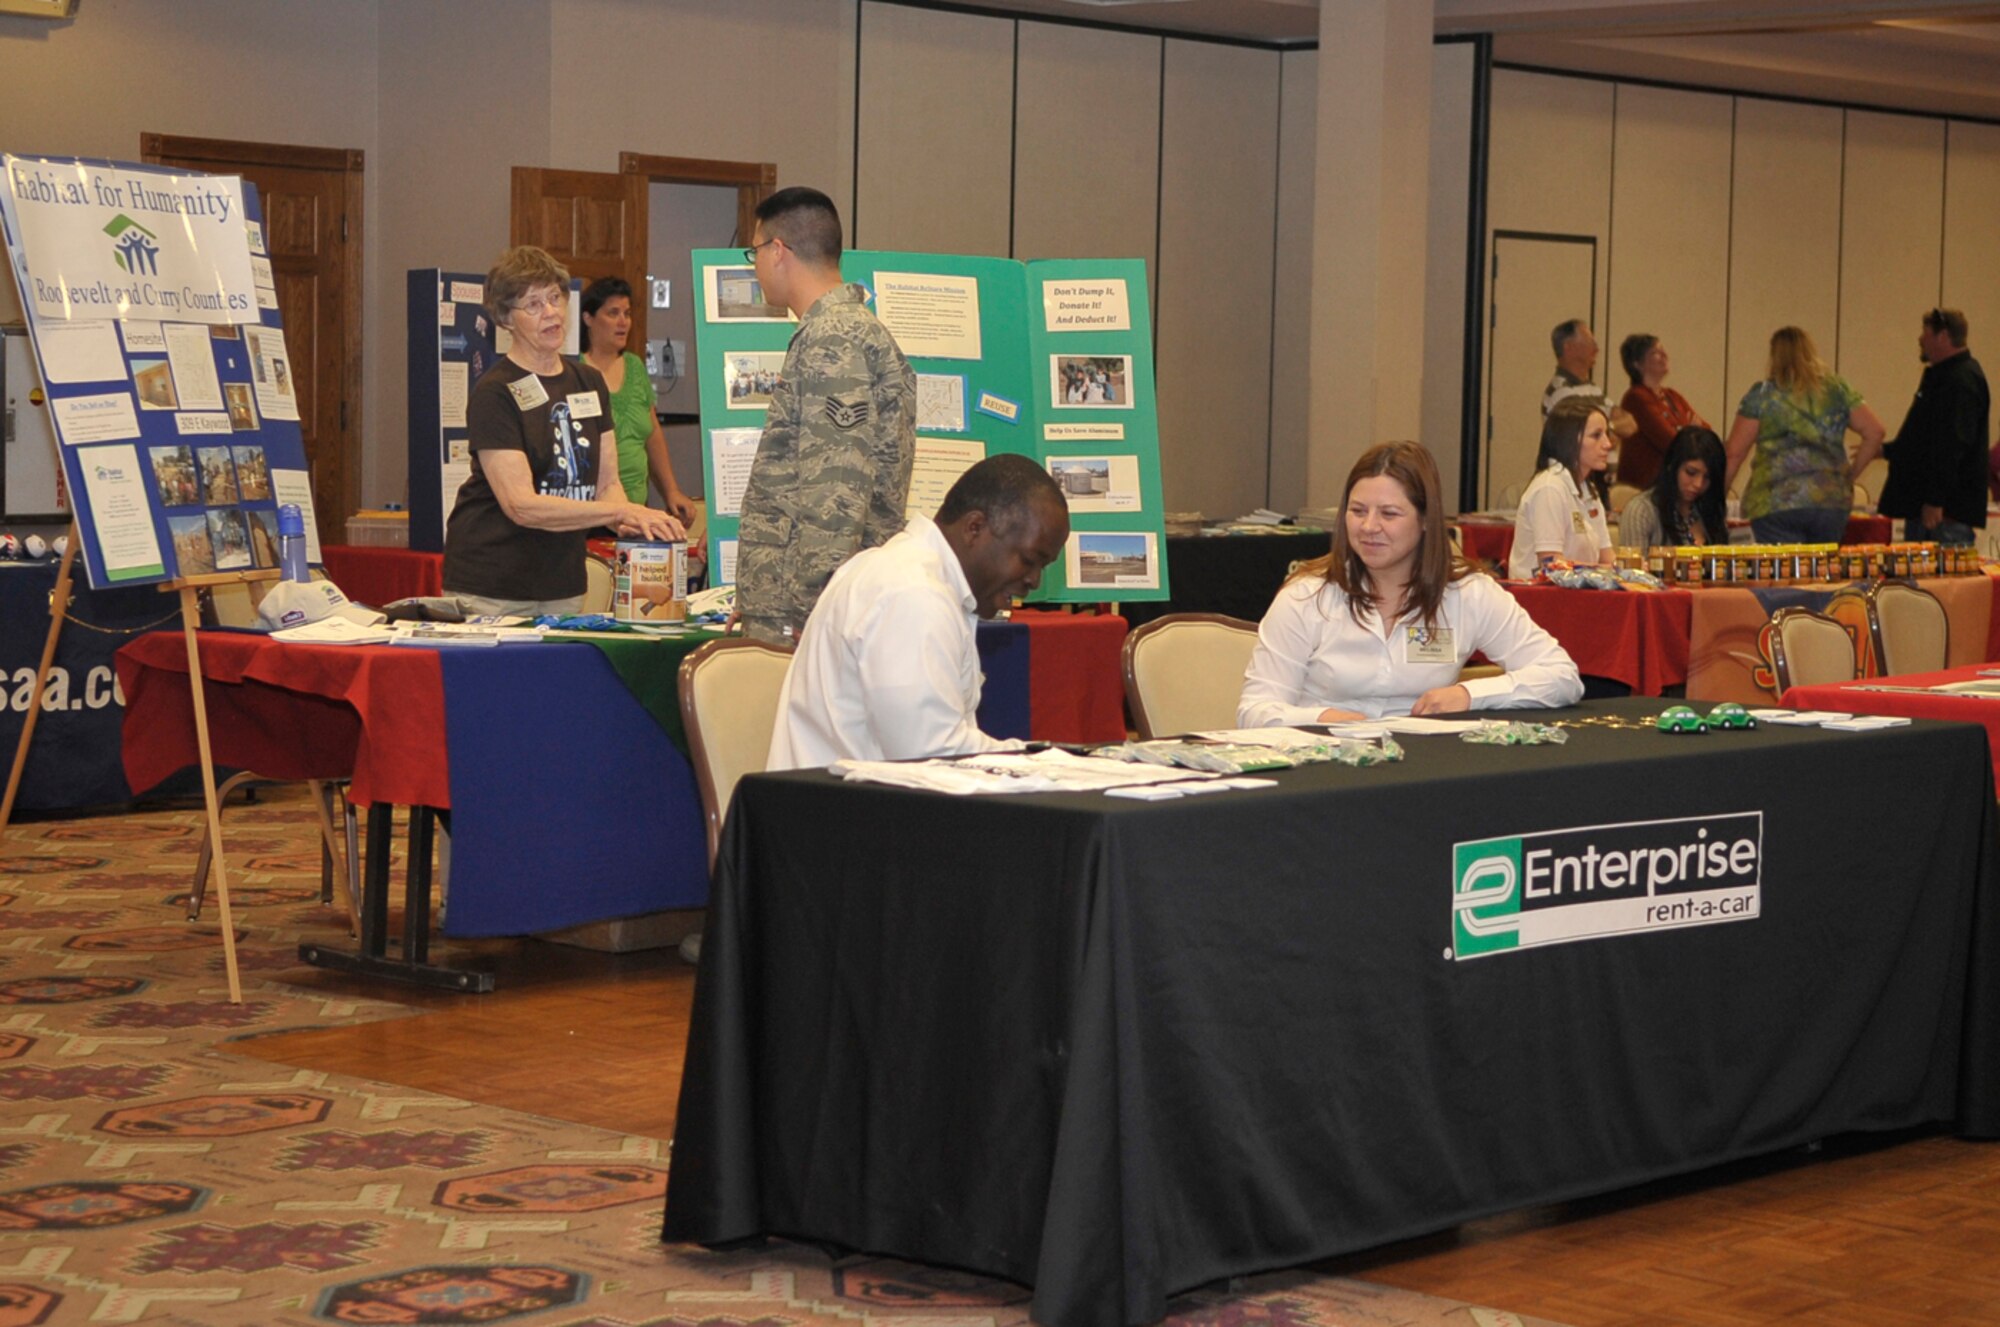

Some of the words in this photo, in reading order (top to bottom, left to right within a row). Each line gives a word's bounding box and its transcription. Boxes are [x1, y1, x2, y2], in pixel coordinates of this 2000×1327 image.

[94, 175, 124, 208] for
[127, 179, 233, 223] Humanity
[115, 282, 142, 306] and
[182, 287, 249, 310] Countes
[1054, 288, 1076, 296] Don't
[1078, 287, 1104, 297] Dump
[1059, 302, 1090, 310] Donate
[1056, 316, 1073, 324] And
[1075, 315, 1105, 323] Deduct
[640, 565, 668, 575] helped
[641, 575, 662, 583] build
[1524, 826, 1757, 899] Enterprise
[1646, 897, 1754, 923] rent-a-car
